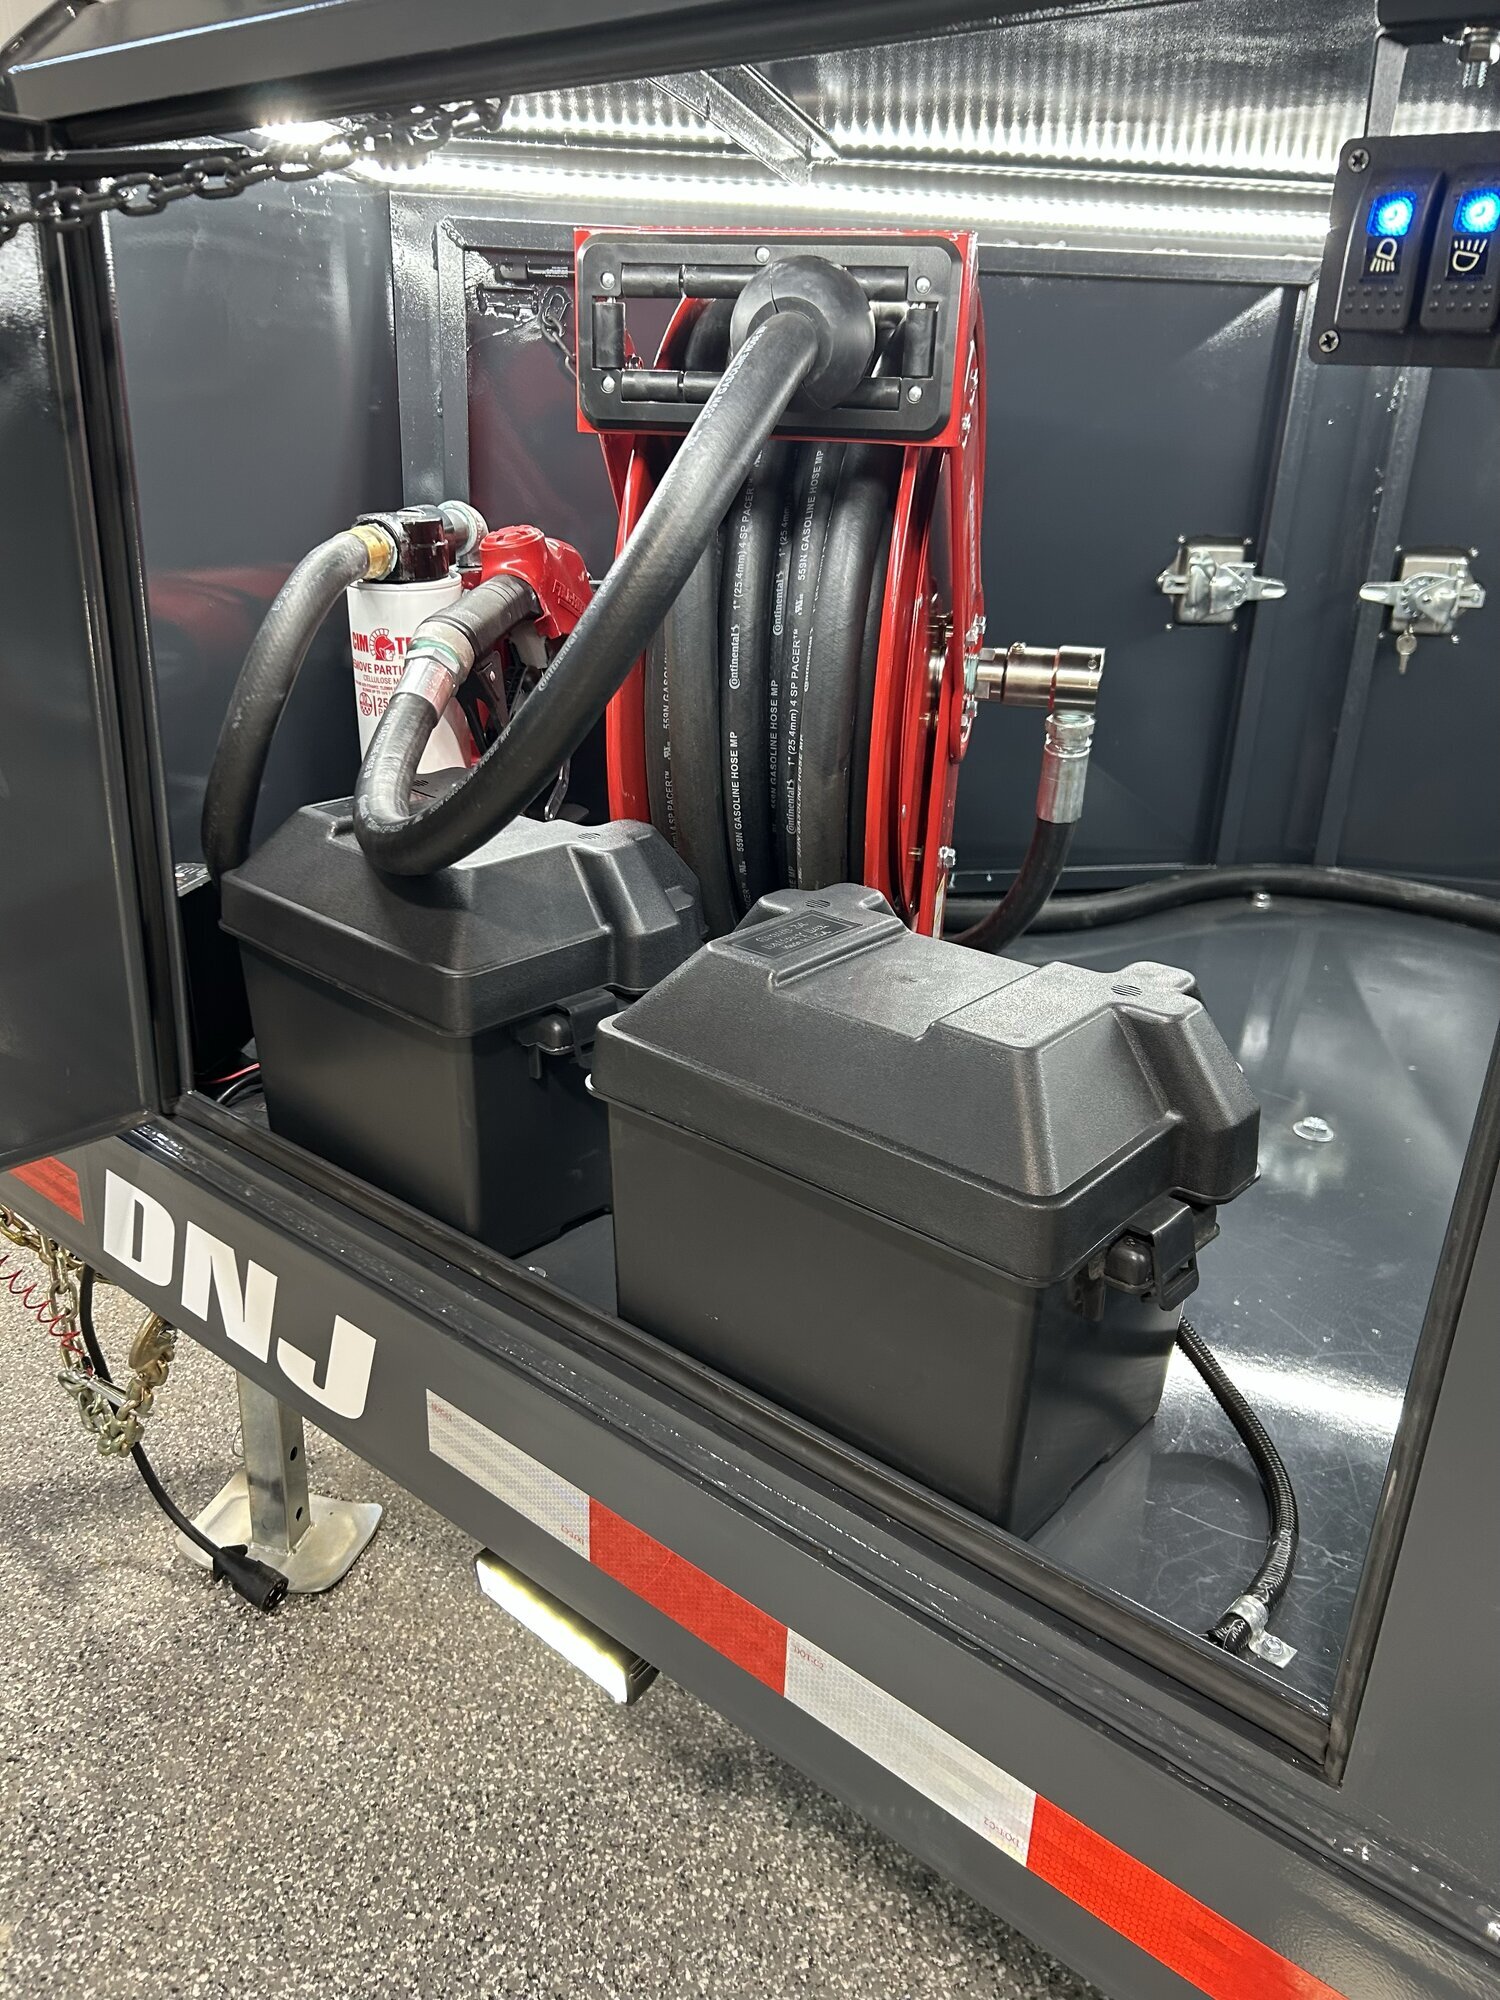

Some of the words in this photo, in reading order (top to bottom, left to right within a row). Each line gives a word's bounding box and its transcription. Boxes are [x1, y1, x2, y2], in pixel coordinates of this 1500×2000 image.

[810, 466, 822, 494] HOSE
[801, 496, 816, 551] GASOLINE
[798, 554, 808, 580] 559N
[729, 630, 740, 690] Continental
[740, 525, 748, 540] SP
[773, 576, 784, 636] Continental
[352, 632, 369, 652] CIM
[770, 680, 778, 696] MP
[790, 682, 798, 697] SP
[730, 732, 738, 748] MP
[730, 750, 739, 779] HOSE
[732, 781, 742, 830] GASOLINE
[786, 783, 797, 834] Continental
[103, 1169, 376, 1420] DNJ
[794, 1646, 824, 1671] DOT-C2
